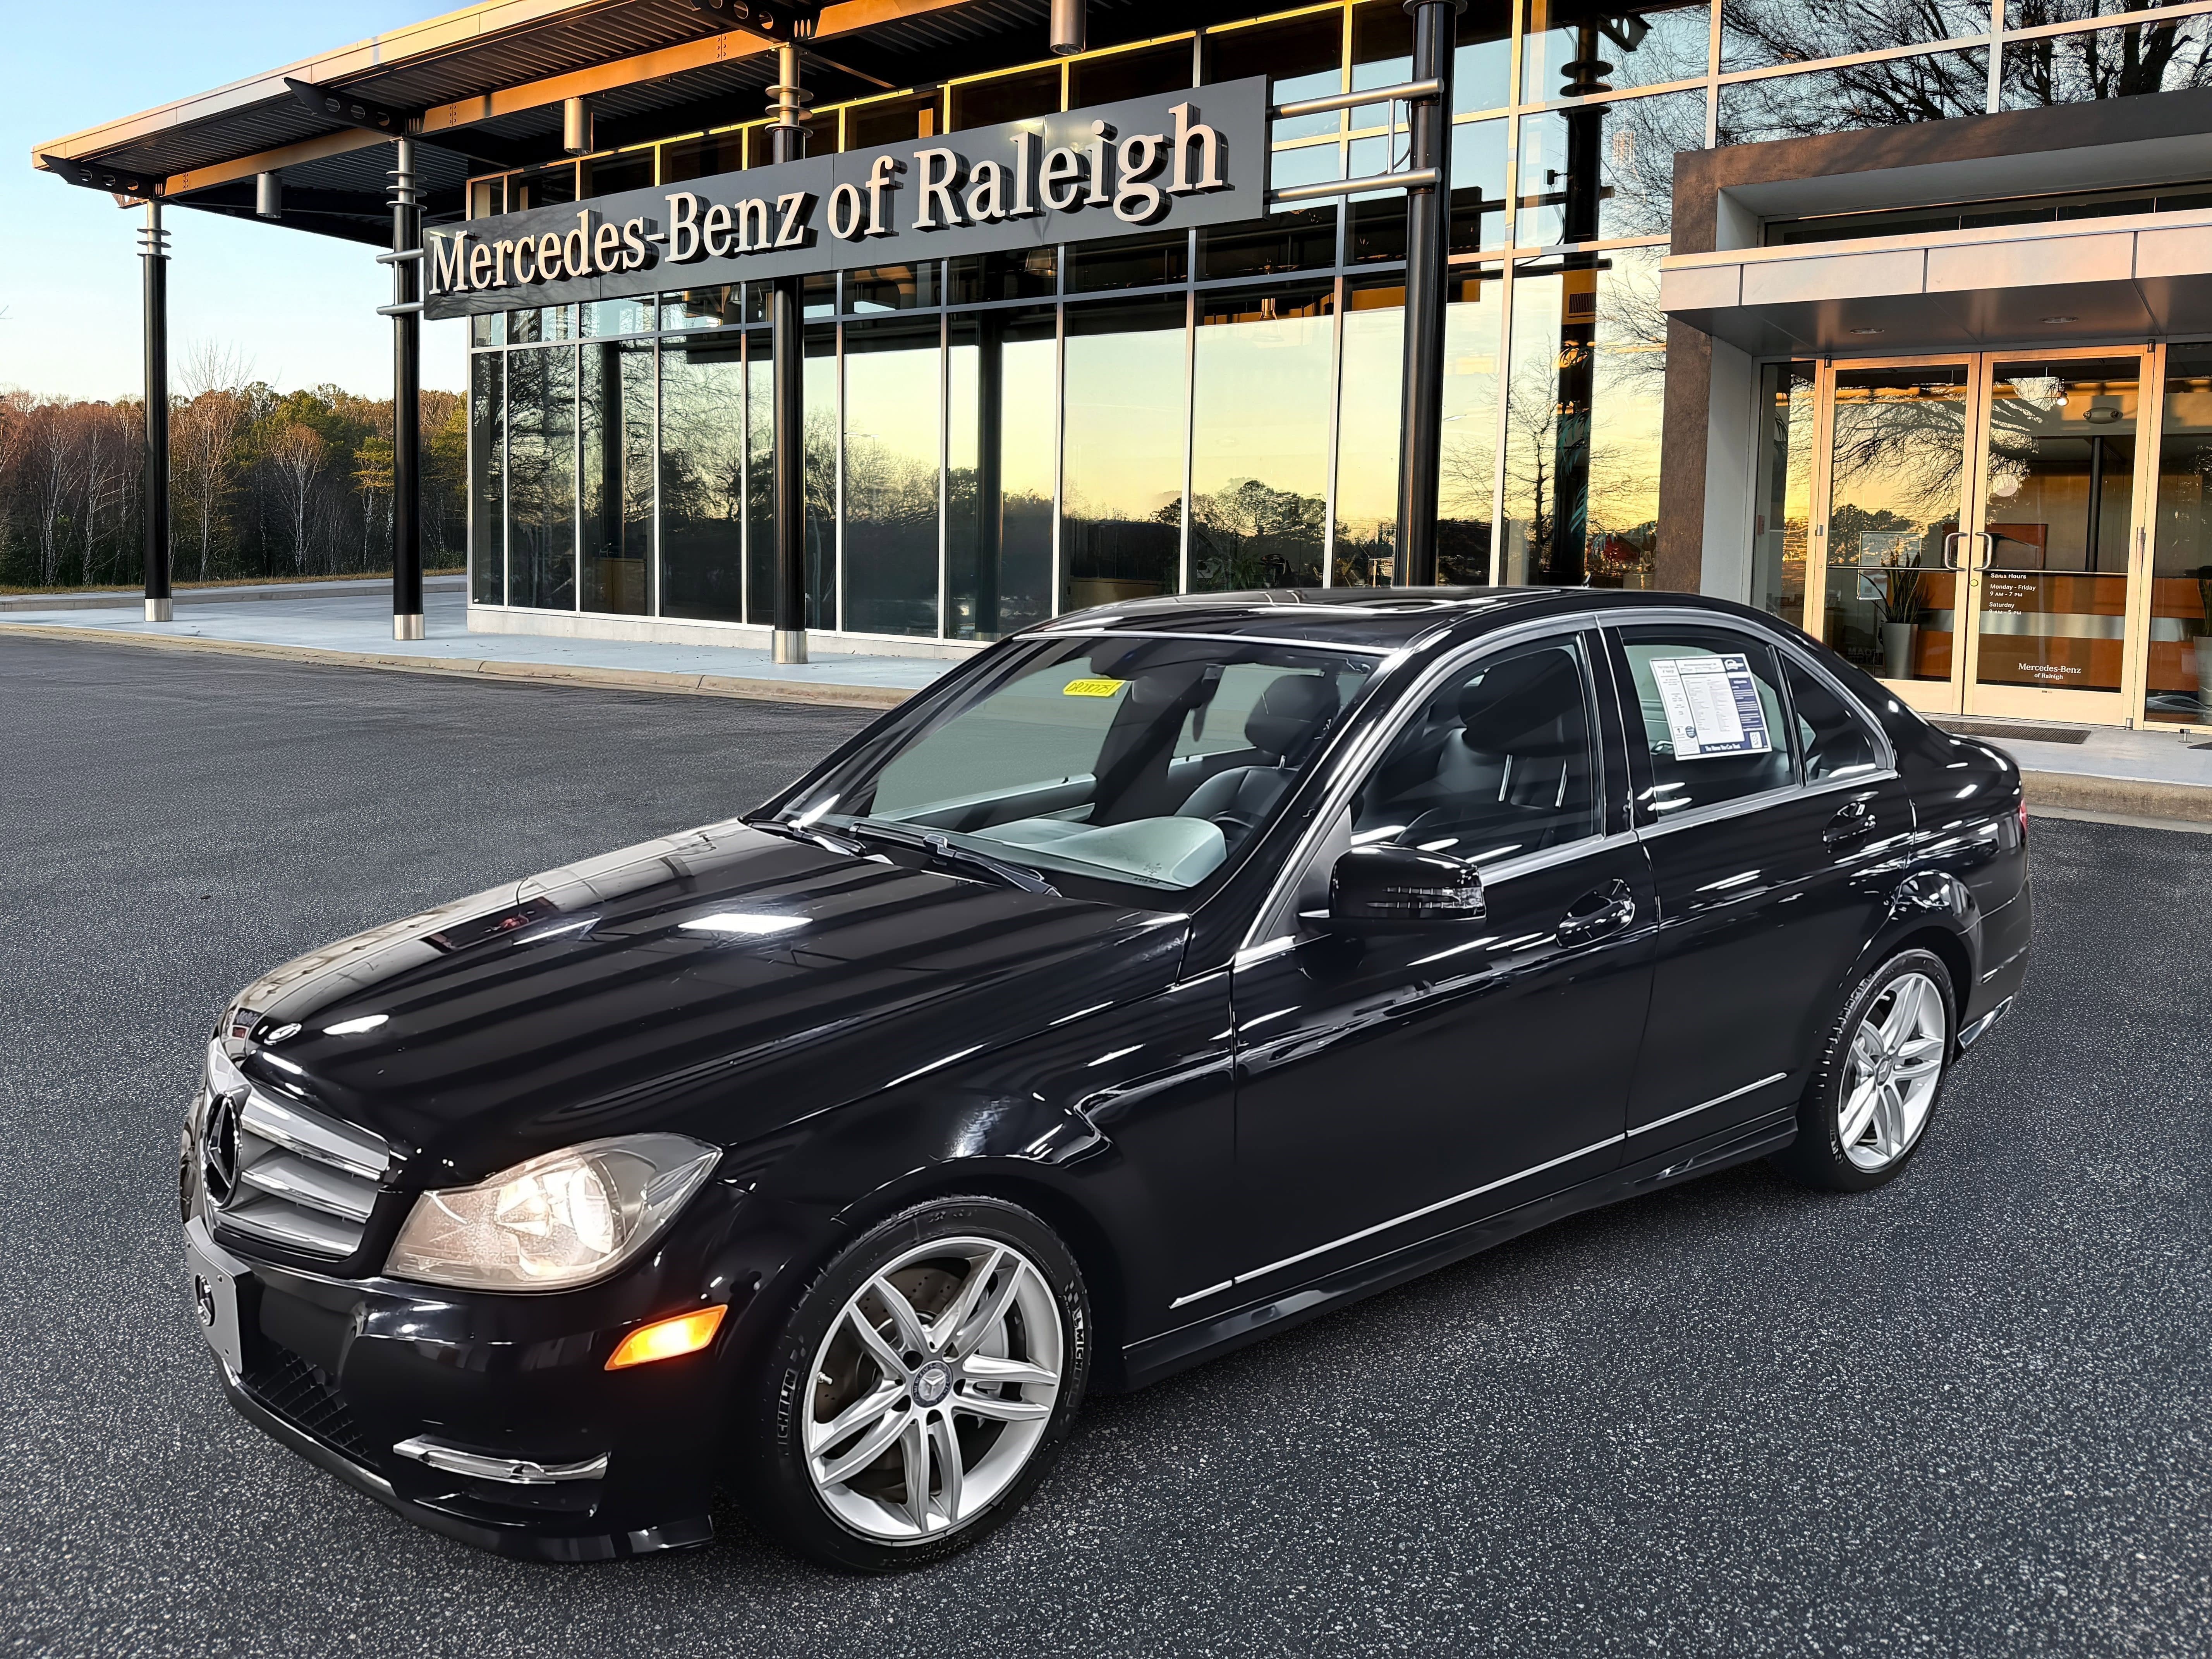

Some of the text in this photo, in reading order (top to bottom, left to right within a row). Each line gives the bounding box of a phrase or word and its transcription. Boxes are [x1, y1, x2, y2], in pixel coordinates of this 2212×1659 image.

[429, 101, 1223, 295] Mercedes-Benz of Raleigh
[2018, 663, 2081, 674] Mercedes-Benz
